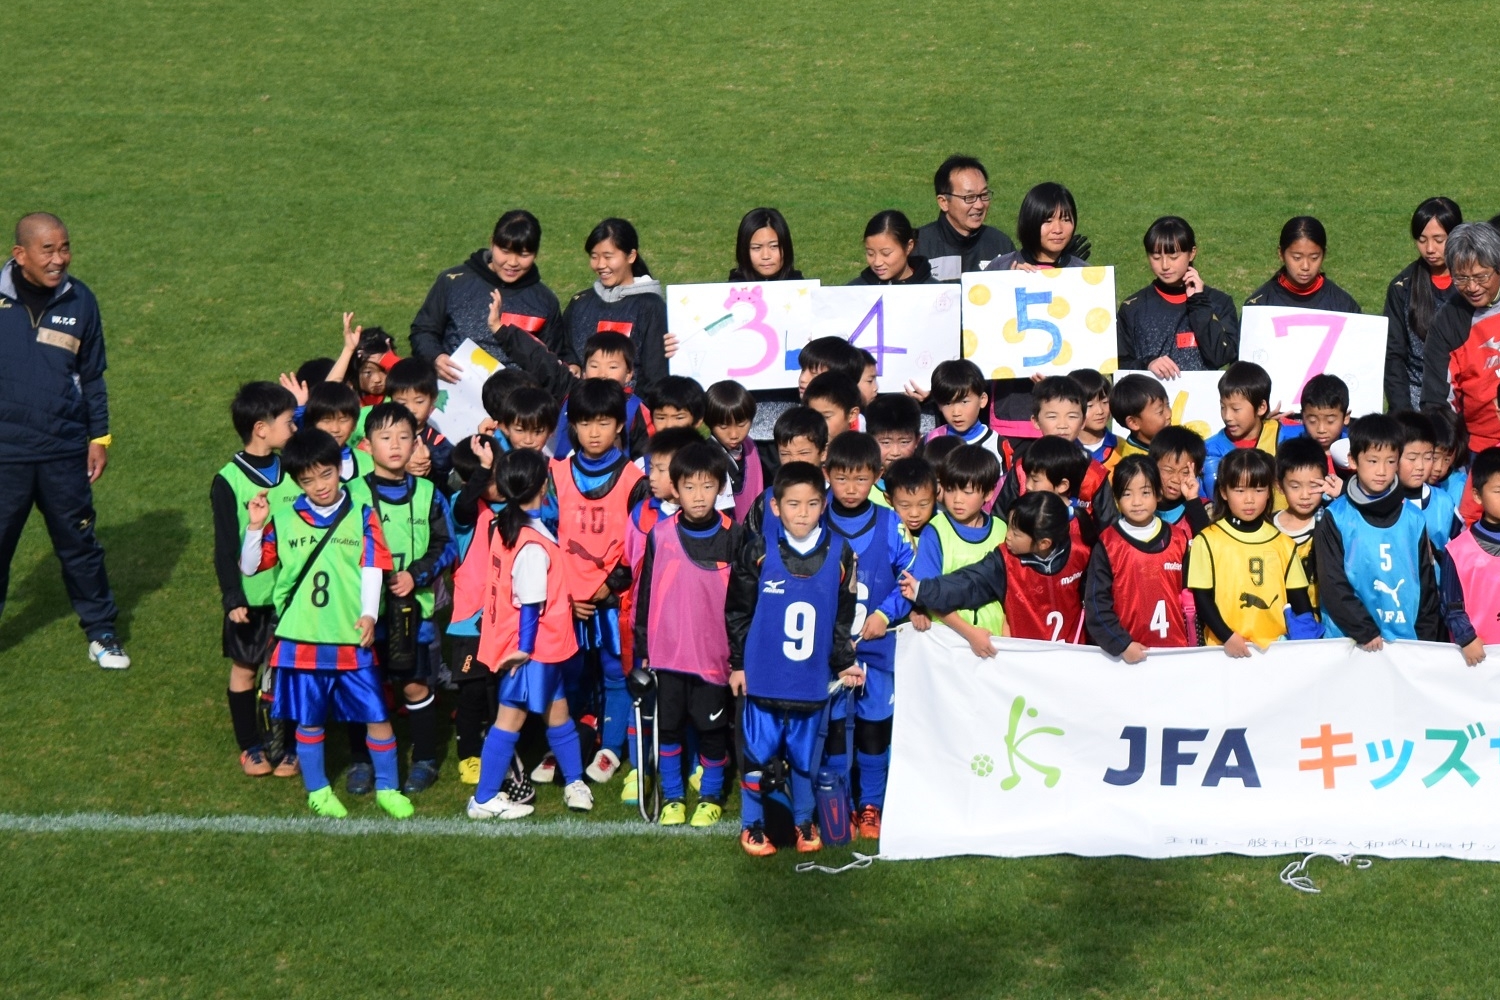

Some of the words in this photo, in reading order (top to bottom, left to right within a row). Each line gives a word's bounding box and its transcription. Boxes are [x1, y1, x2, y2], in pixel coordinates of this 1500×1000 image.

[722, 287, 780, 378] 3
[848, 294, 907, 378] 4
[1014, 286, 1063, 368] 5
[1271, 313, 1349, 405] 7
[580, 505, 605, 534] 10
[288, 535, 318, 549] WFA
[1379, 543, 1392, 572] 5
[311, 570, 330, 608] 8
[1249, 556, 1264, 587] 9
[783, 601, 816, 661] 9
[1046, 610, 1066, 643] 2
[1150, 600, 1170, 638] 4
[1103, 725, 1262, 789] JFA
